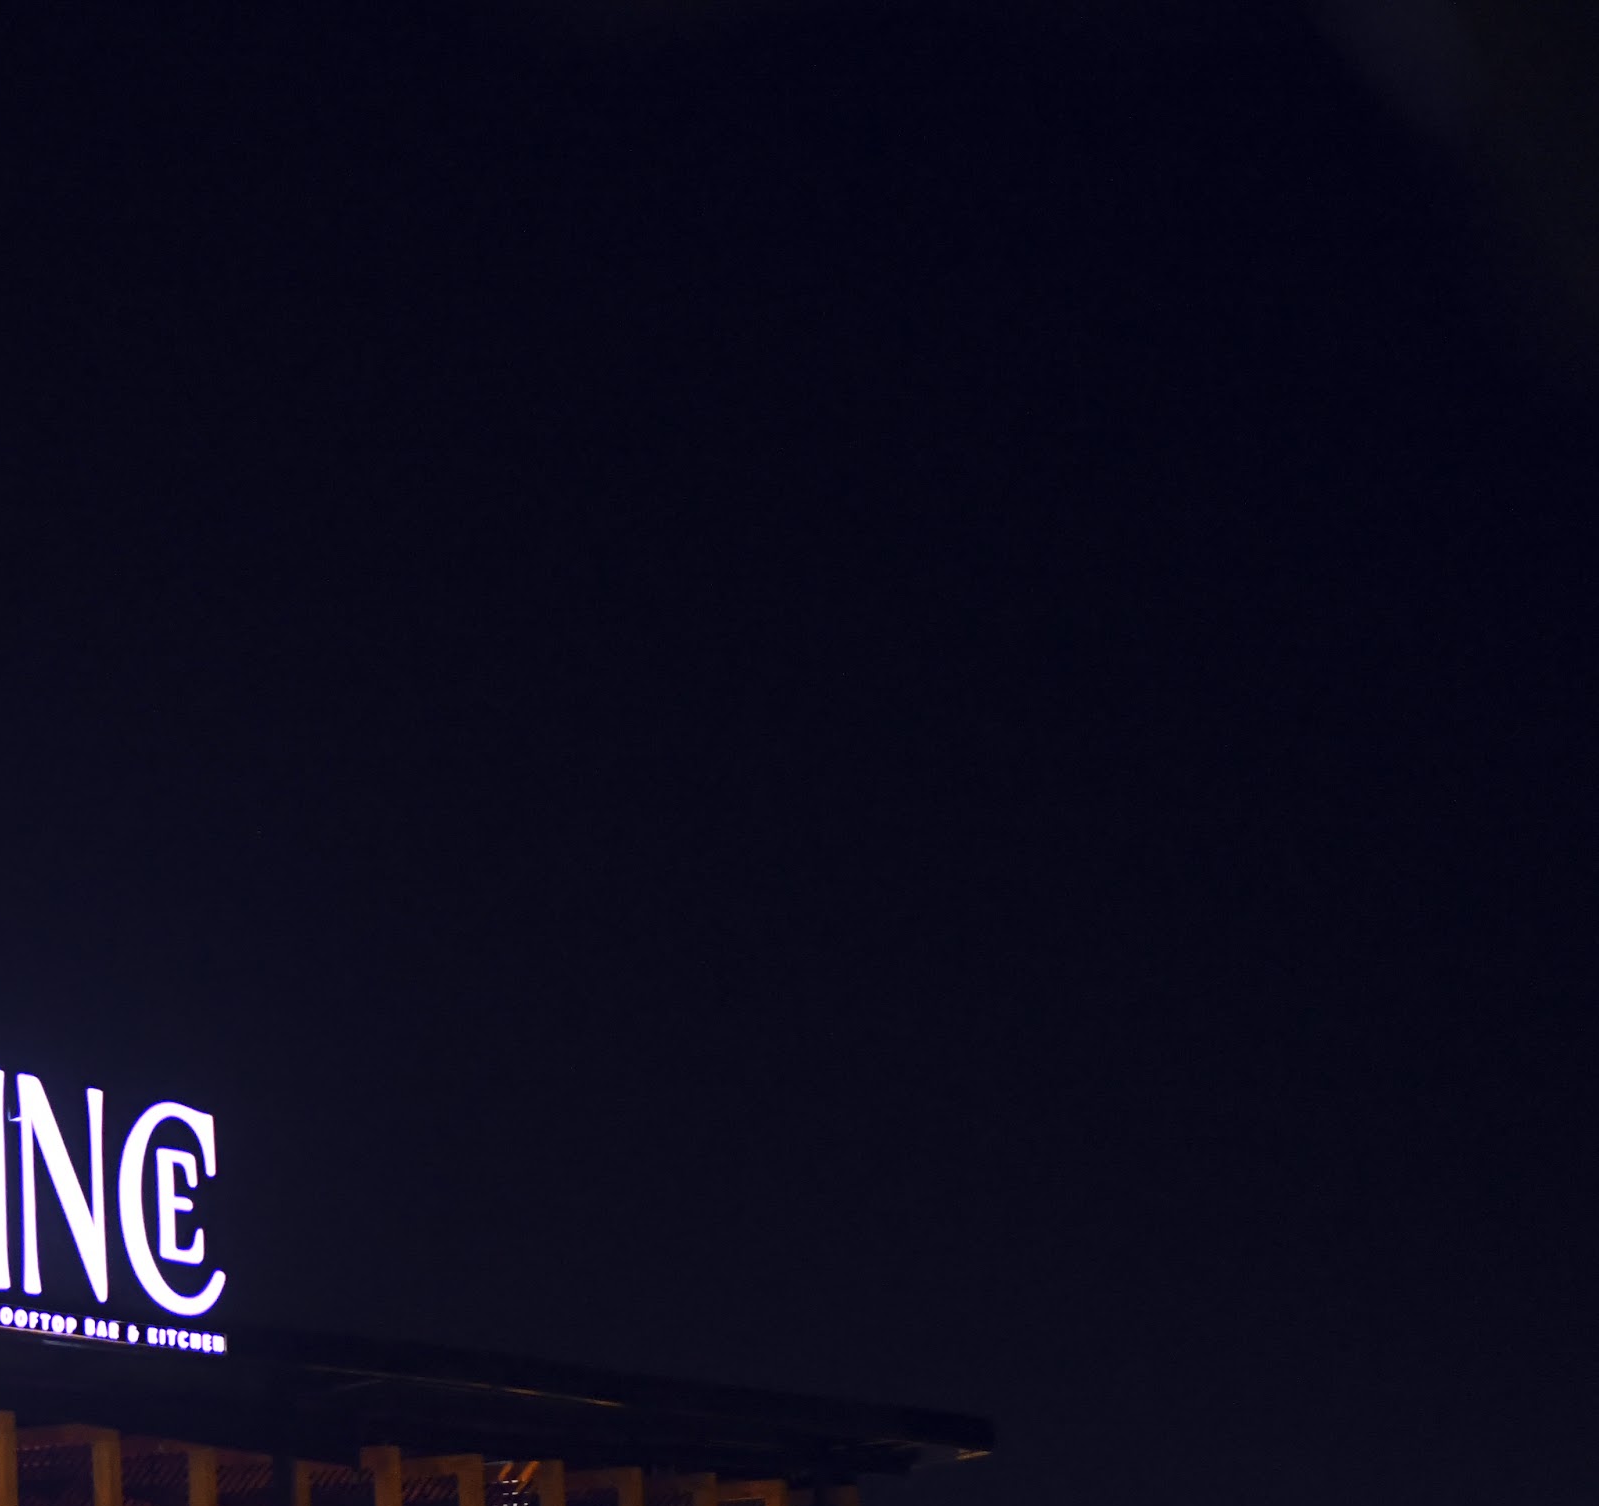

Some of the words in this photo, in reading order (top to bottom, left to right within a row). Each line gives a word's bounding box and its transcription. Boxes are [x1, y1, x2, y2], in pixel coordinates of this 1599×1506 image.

[84, 1317, 120, 1340] BAR
[127, 1323, 140, 1343] &
[146, 1326, 225, 1353] KITCHEN
